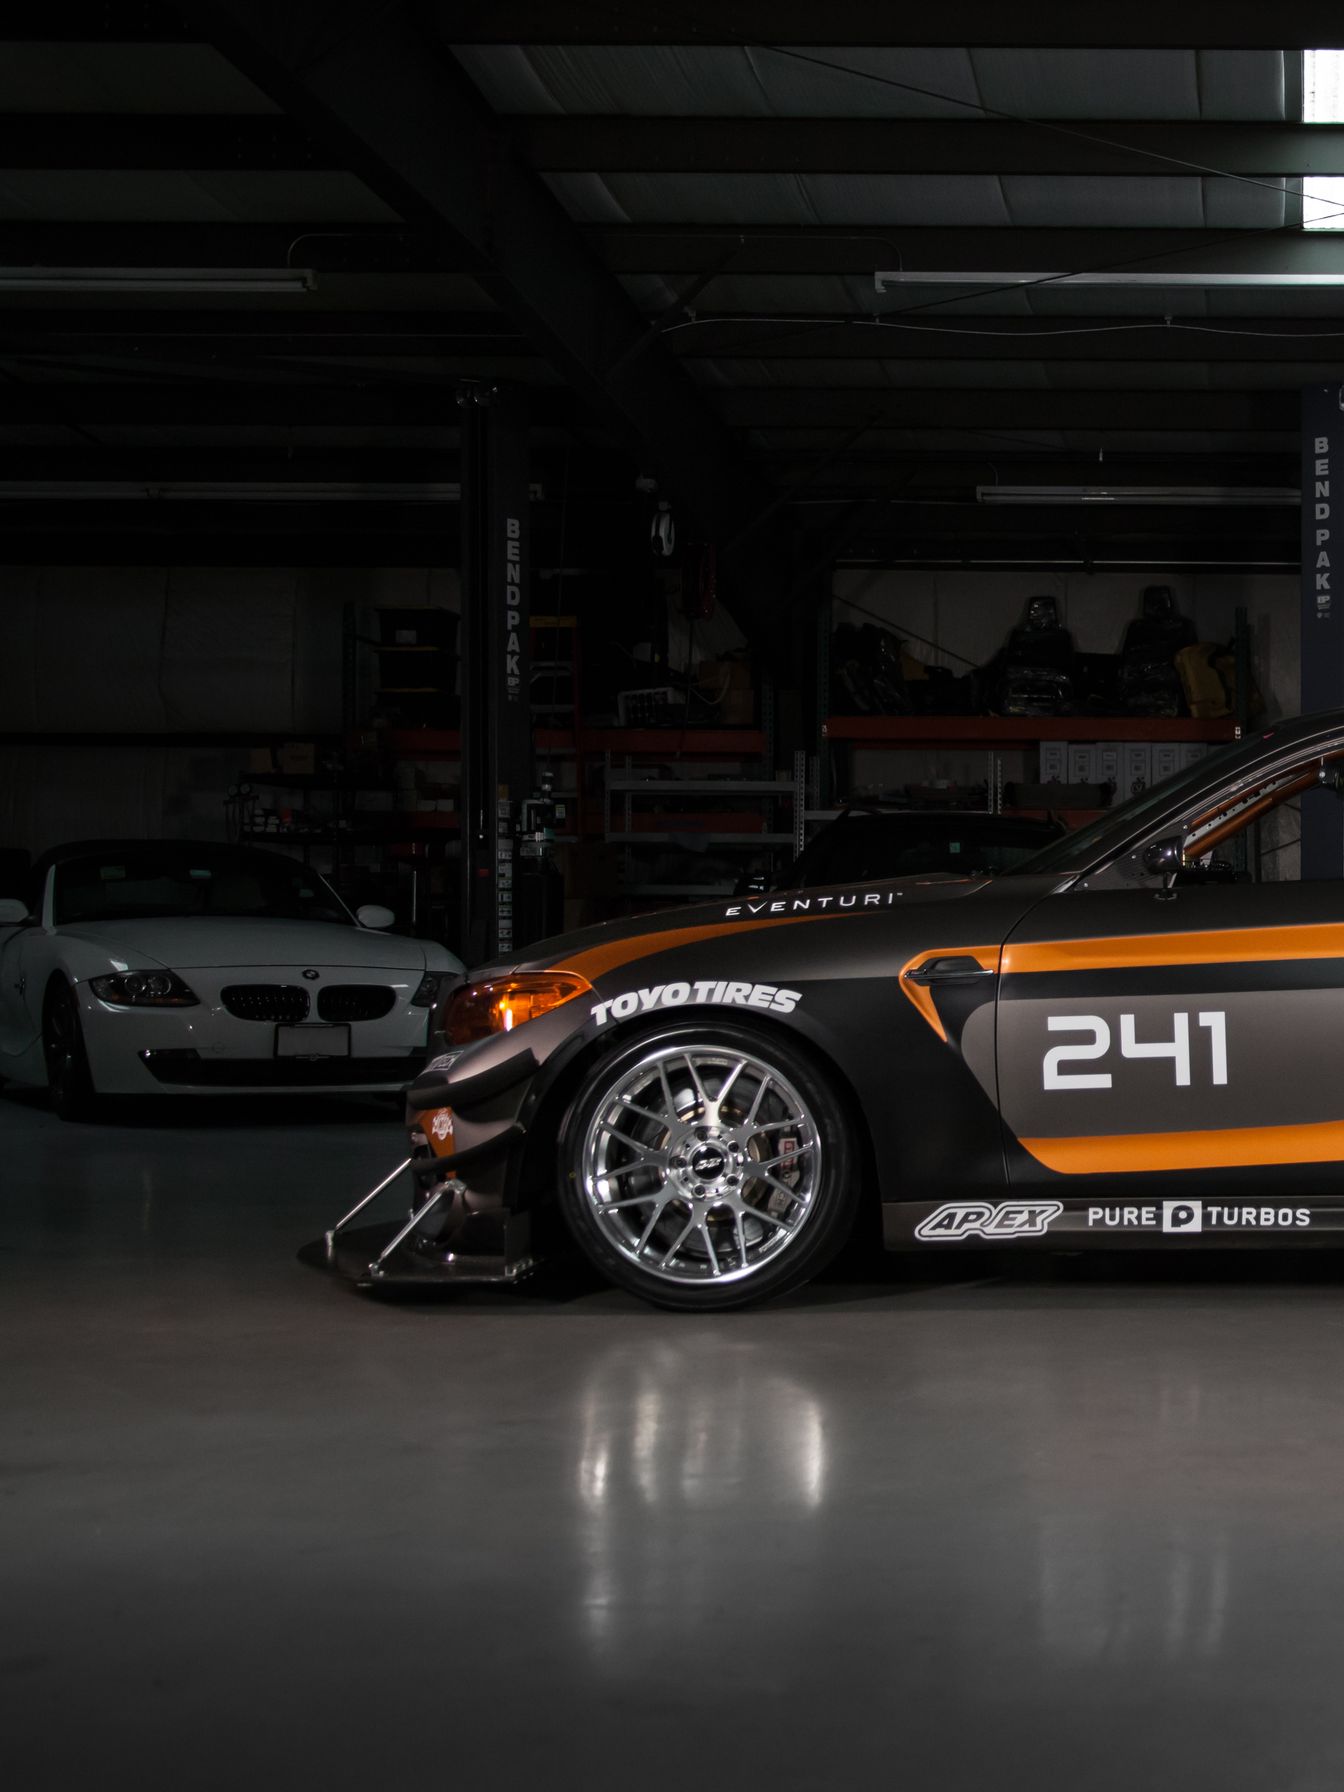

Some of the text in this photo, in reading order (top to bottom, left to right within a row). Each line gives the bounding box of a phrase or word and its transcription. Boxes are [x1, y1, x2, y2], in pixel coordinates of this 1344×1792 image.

[590, 980, 803, 1026] TOYO TIRES
[1042, 1010, 1229, 1091] 241
[921, 1204, 1057, 1236] APEX
[1087, 1206, 1157, 1227] PURE
[1207, 1206, 1311, 1227] TURBOS
